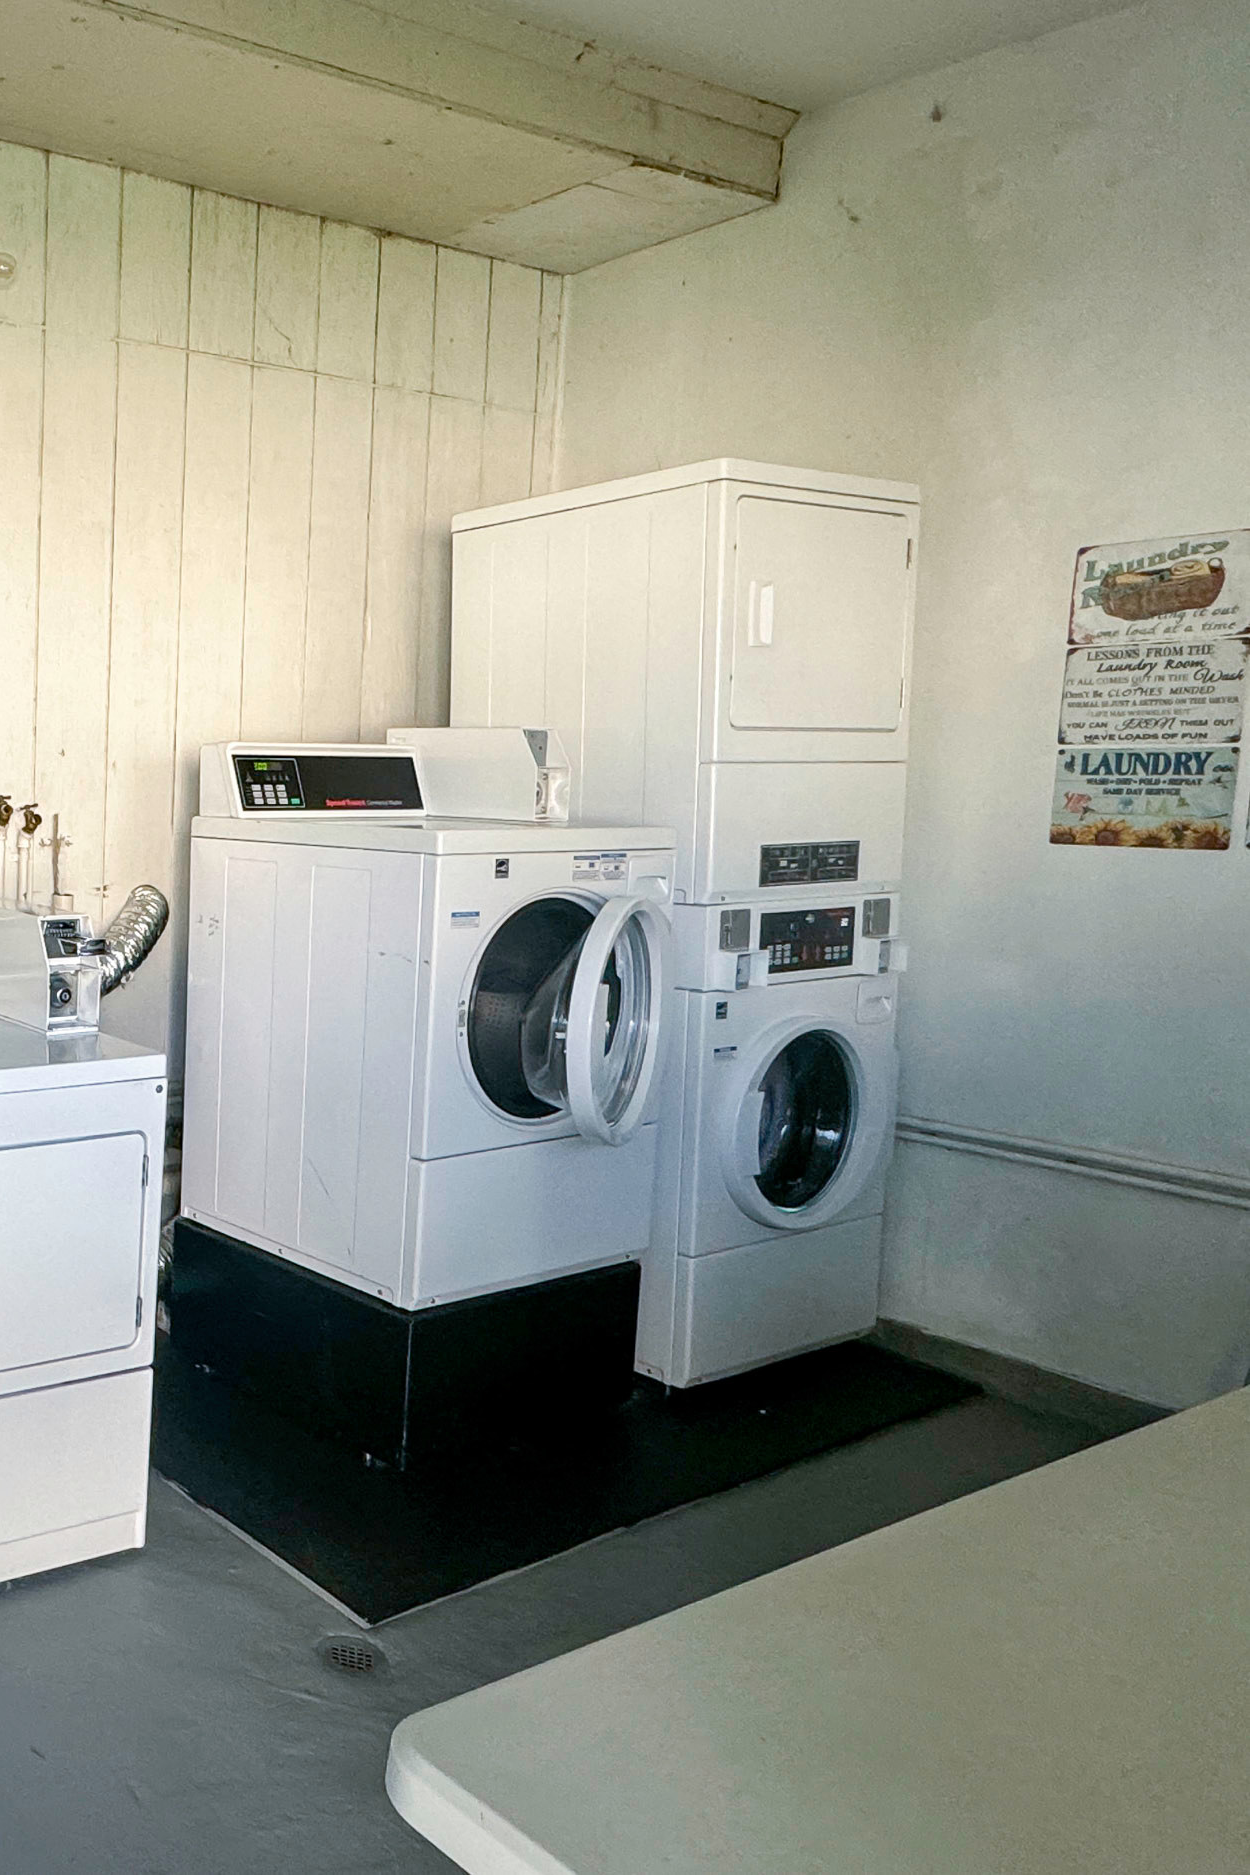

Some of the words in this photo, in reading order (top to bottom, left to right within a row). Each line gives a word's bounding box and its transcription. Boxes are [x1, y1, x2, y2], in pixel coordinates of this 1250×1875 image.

[1084, 540, 1230, 582] Laundry
[1193, 608, 1208, 617] it
[1211, 604, 1240, 616] out
[1097, 629, 1120, 638] one
[1126, 623, 1157, 636] load
[1163, 624, 1181, 634] at
[1201, 621, 1237, 631] time
[1087, 647, 1140, 661] LESSONS
[1146, 646, 1184, 658] FROM
[1187, 645, 1215, 656] THE
[1096, 658, 1158, 676] Laundry
[1164, 658, 1207, 670] Room
[1077, 678, 1094, 686] ALL
[1096, 676, 1129, 685] COMES
[1131, 675, 1151, 687] OUT
[1154, 674, 1165, 682] IN
[1168, 674, 1189, 682] THE
[1194, 668, 1245, 684] Wash
[1093, 690, 1103, 698] Be
[1108, 687, 1163, 698] CLOTHES
[1169, 685, 1215, 695] MINDED
[1179, 719, 1208, 727] THEM
[1118, 733, 1159, 741] LOADS
[1080, 751, 1214, 776] LAUNDRY
[1138, 777, 1161, 785] FOLD
[1102, 787, 1124, 795] SAME
